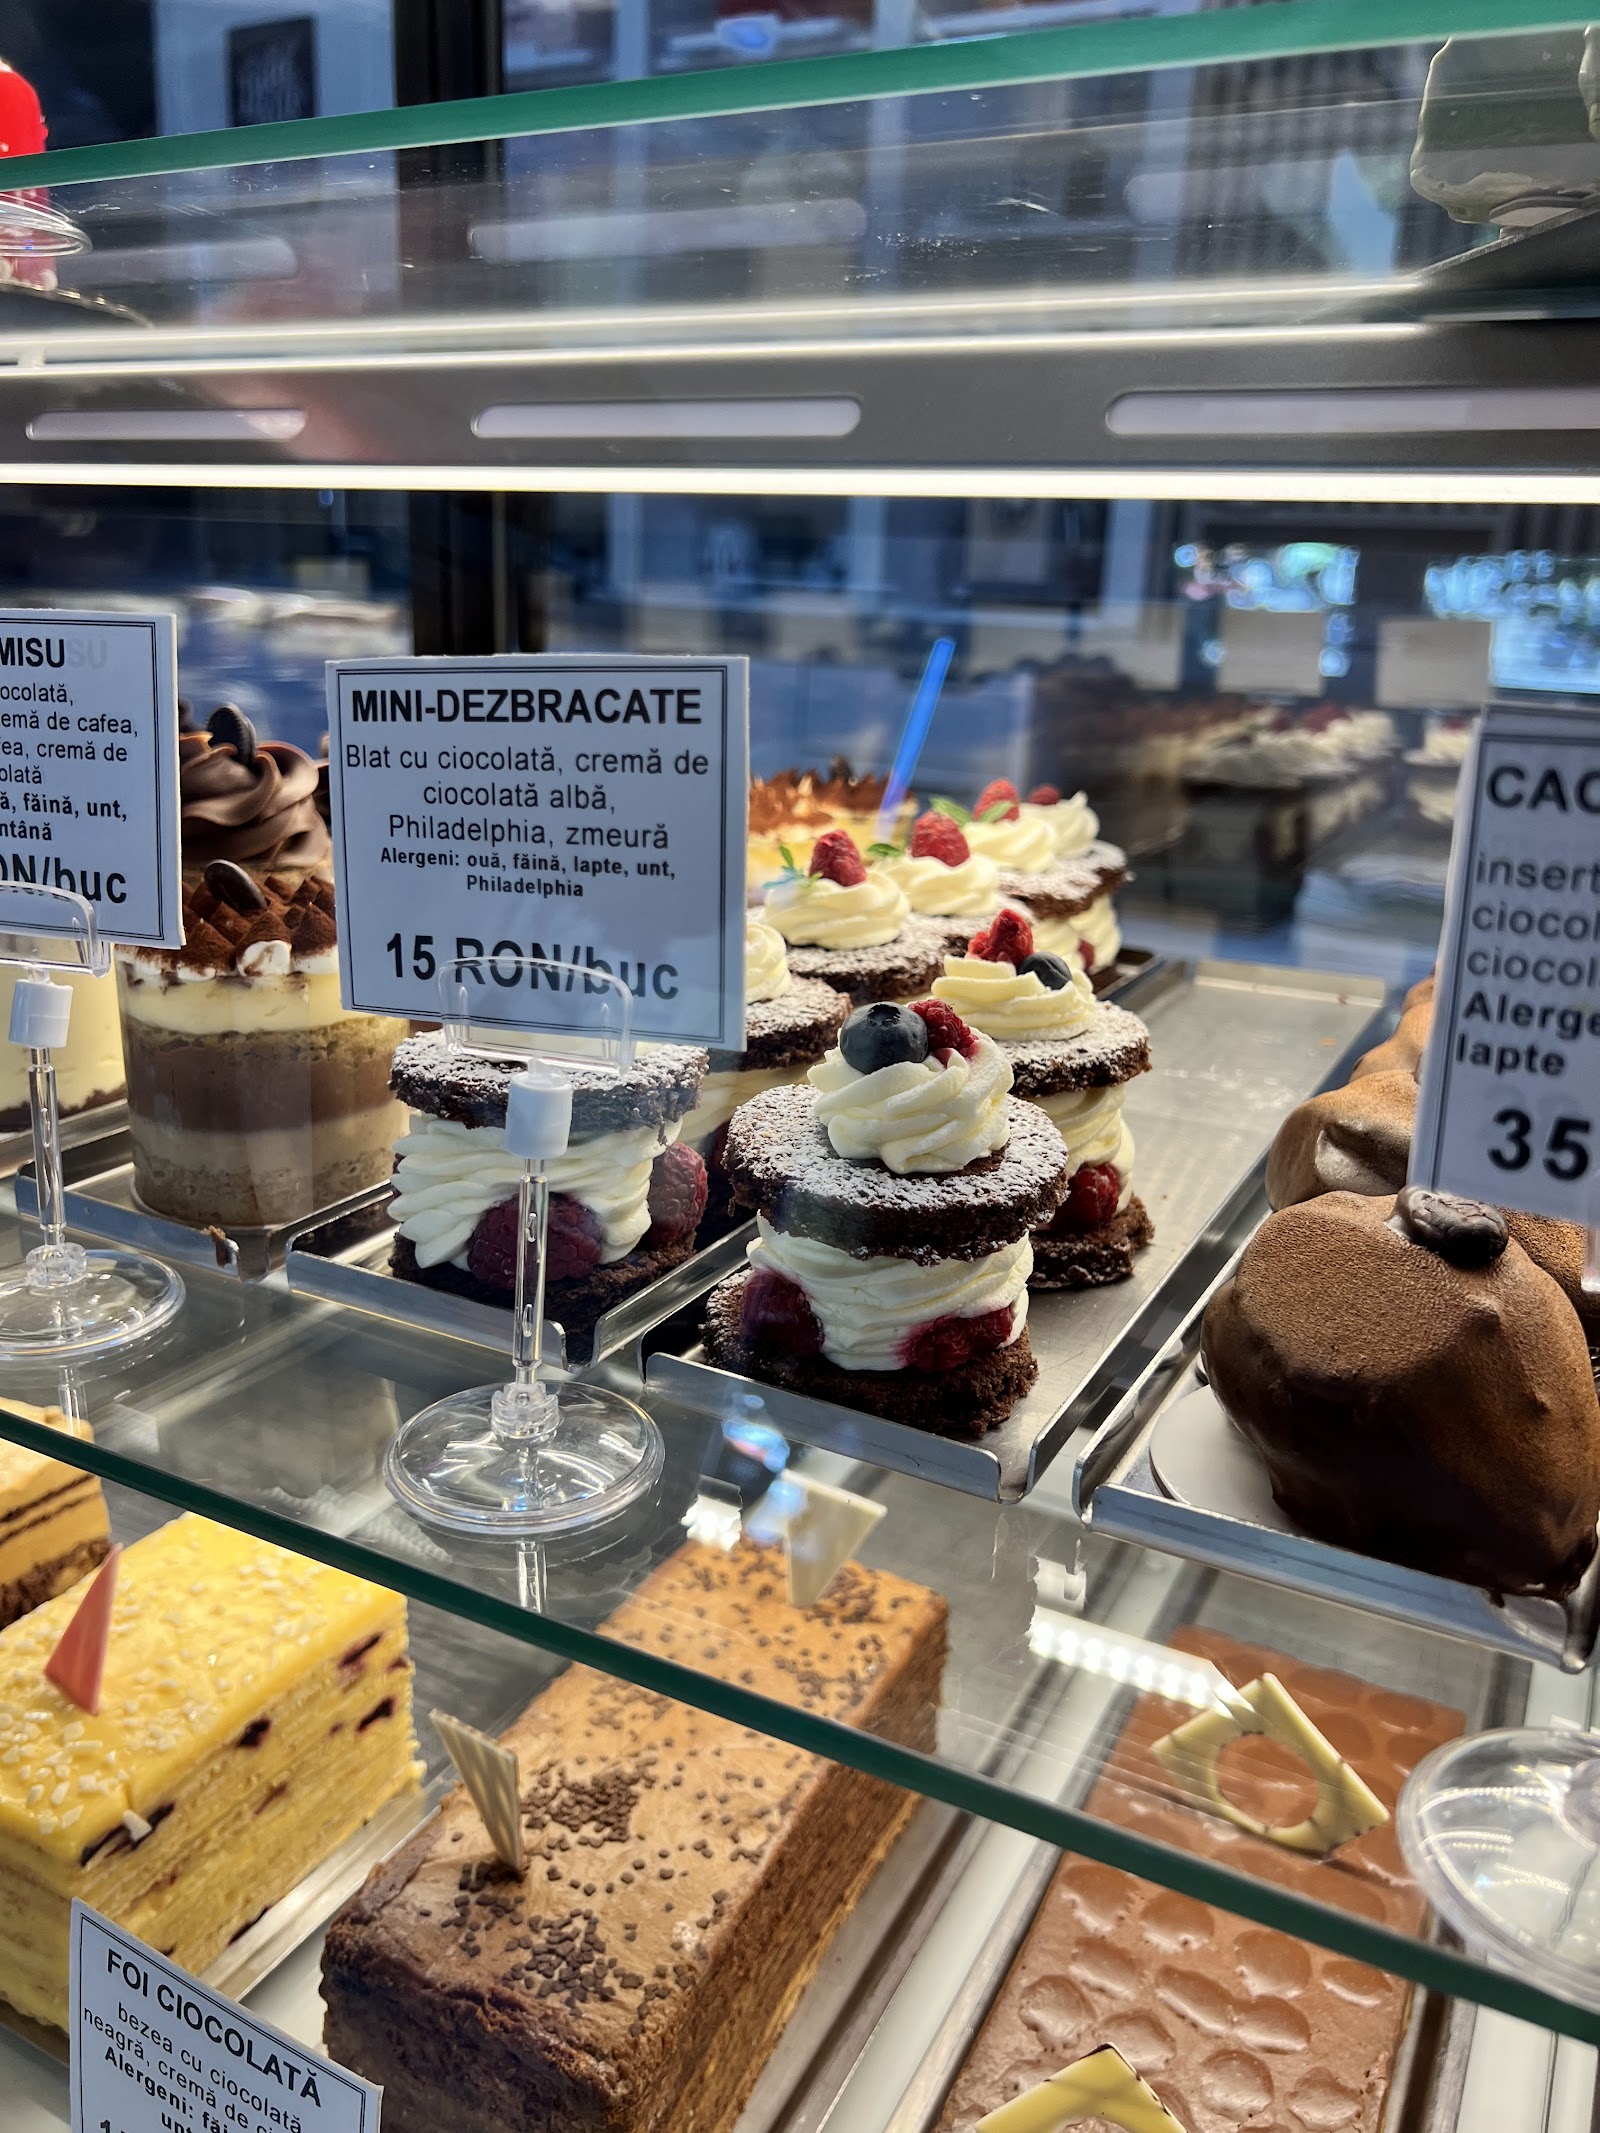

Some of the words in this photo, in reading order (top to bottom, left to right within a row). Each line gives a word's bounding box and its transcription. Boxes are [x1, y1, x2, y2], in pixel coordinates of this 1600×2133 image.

[0, 637, 65, 668] MISU
[47, 711, 70, 731] de
[77, 714, 139, 737] cafea,
[351, 688, 702, 725] MINI-DEZBRACATE
[0, 736, 29, 759] ea,
[37, 740, 96, 761] cremă
[104, 743, 128, 761] de
[347, 745, 390, 769] Blat
[400, 750, 428, 769] cu
[438, 746, 563, 774] ciocolată,
[575, 748, 662, 774] cremă
[674, 749, 709, 776] de
[23, 793, 79, 818] făină,
[87, 800, 127, 821] unt,
[423, 783, 538, 808] ciocolată
[549, 784, 615, 813] albă,
[388, 815, 554, 848] Philadelphia,
[565, 824, 669, 850] zmeură
[0, 853, 127, 903] N/buc
[380, 848, 460, 868] Alergeni:
[467, 853, 507, 870] ouă,
[513, 852, 567, 873] făină,
[574, 856, 629, 877] lapte,
[636, 861, 676, 880] unt,
[466, 874, 584, 899] Philadelphia
[386, 933, 436, 981] 15
[454, 937, 680, 1001] RON/buc
[1455, 1032, 1568, 1077] lapte
[1487, 1107, 1591, 1182] 35
[107, 1949, 148, 1997] FOI
[157, 1984, 321, 2108] CIOCOLATĂ
[84, 2007, 150, 2066] neagră,
[158, 2060, 216, 2109] cremă
[225, 2103, 249, 2129] de
[104, 2046, 193, 2119] Alergeni:
[118, 2002, 173, 2054] bezea
[181, 2049, 202, 2073] cu
[210, 2068, 301, 2133] ciocolată
